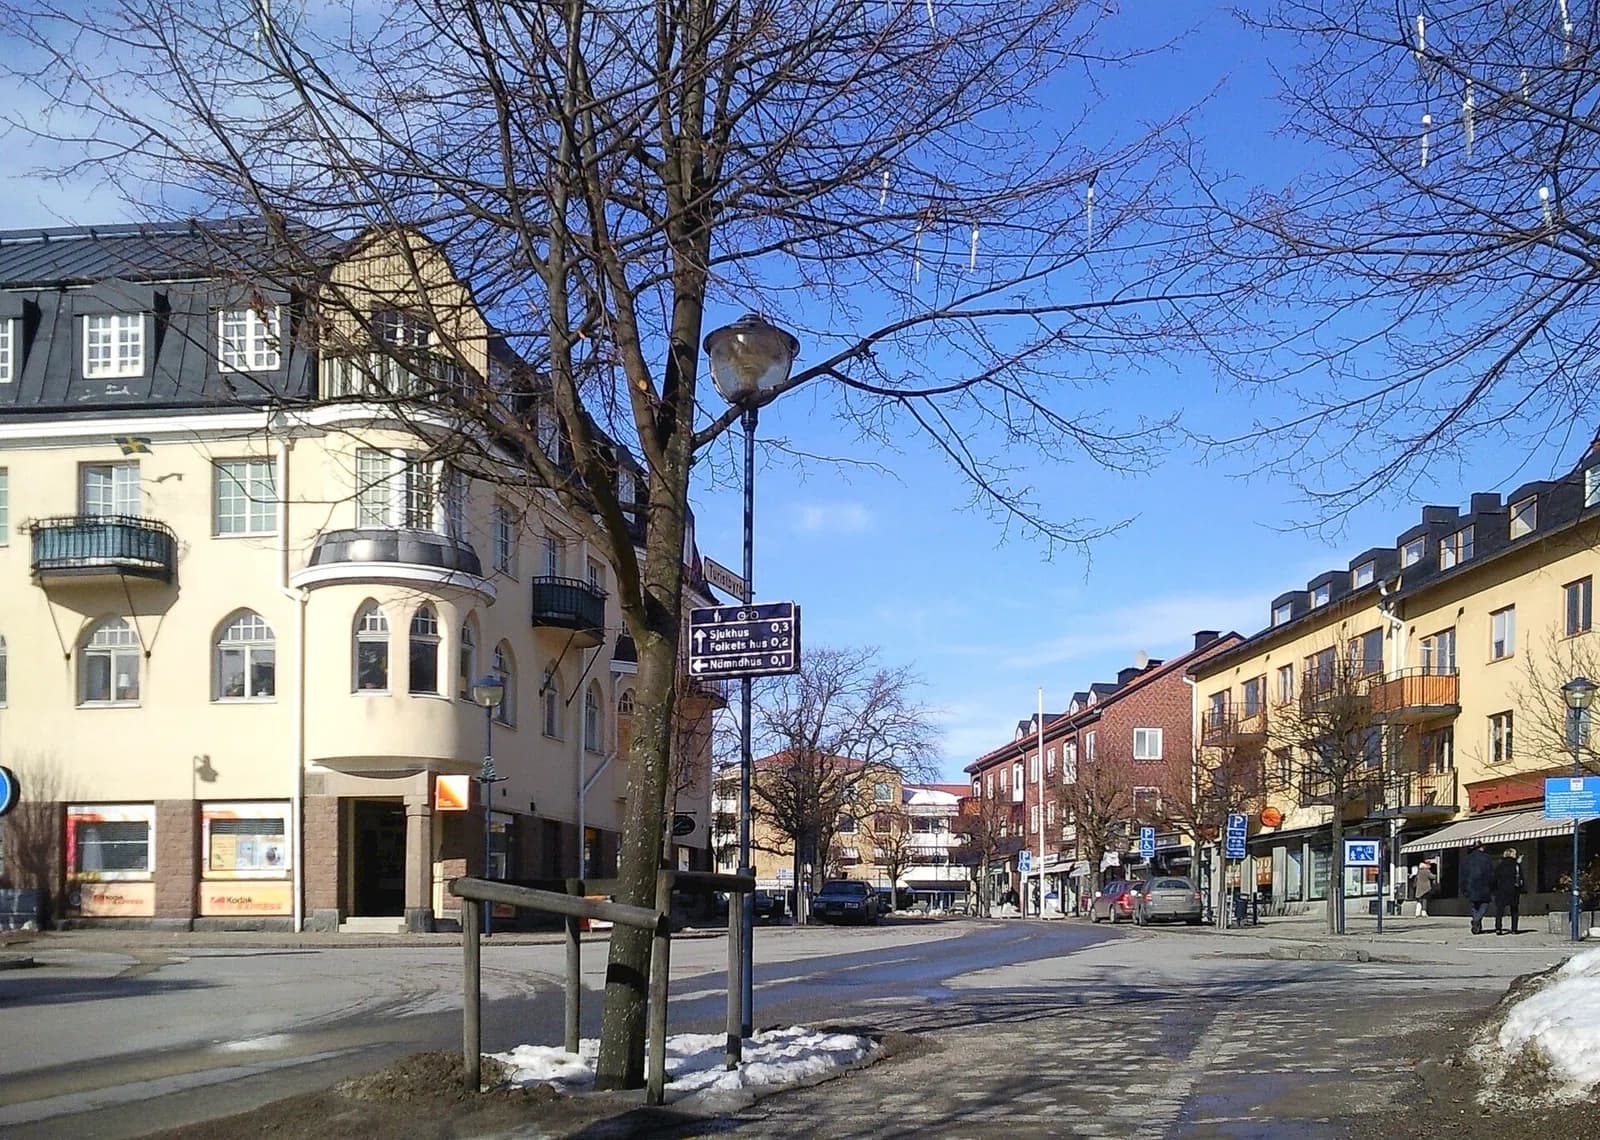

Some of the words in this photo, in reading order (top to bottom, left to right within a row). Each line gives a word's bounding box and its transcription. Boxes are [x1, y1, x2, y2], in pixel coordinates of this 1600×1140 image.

[709, 629, 750, 641] Sjukhus
[770, 622, 789, 634] 0,3
[710, 641, 747, 652] Folkets
[749, 639, 768, 649] hus
[770, 637, 789, 649] 0,2
[709, 657, 762, 670] Nämndhus
[770, 654, 786, 667] 0,1
[1234, 816, 1243, 827] P
[226, 896, 252, 904] Kodak
